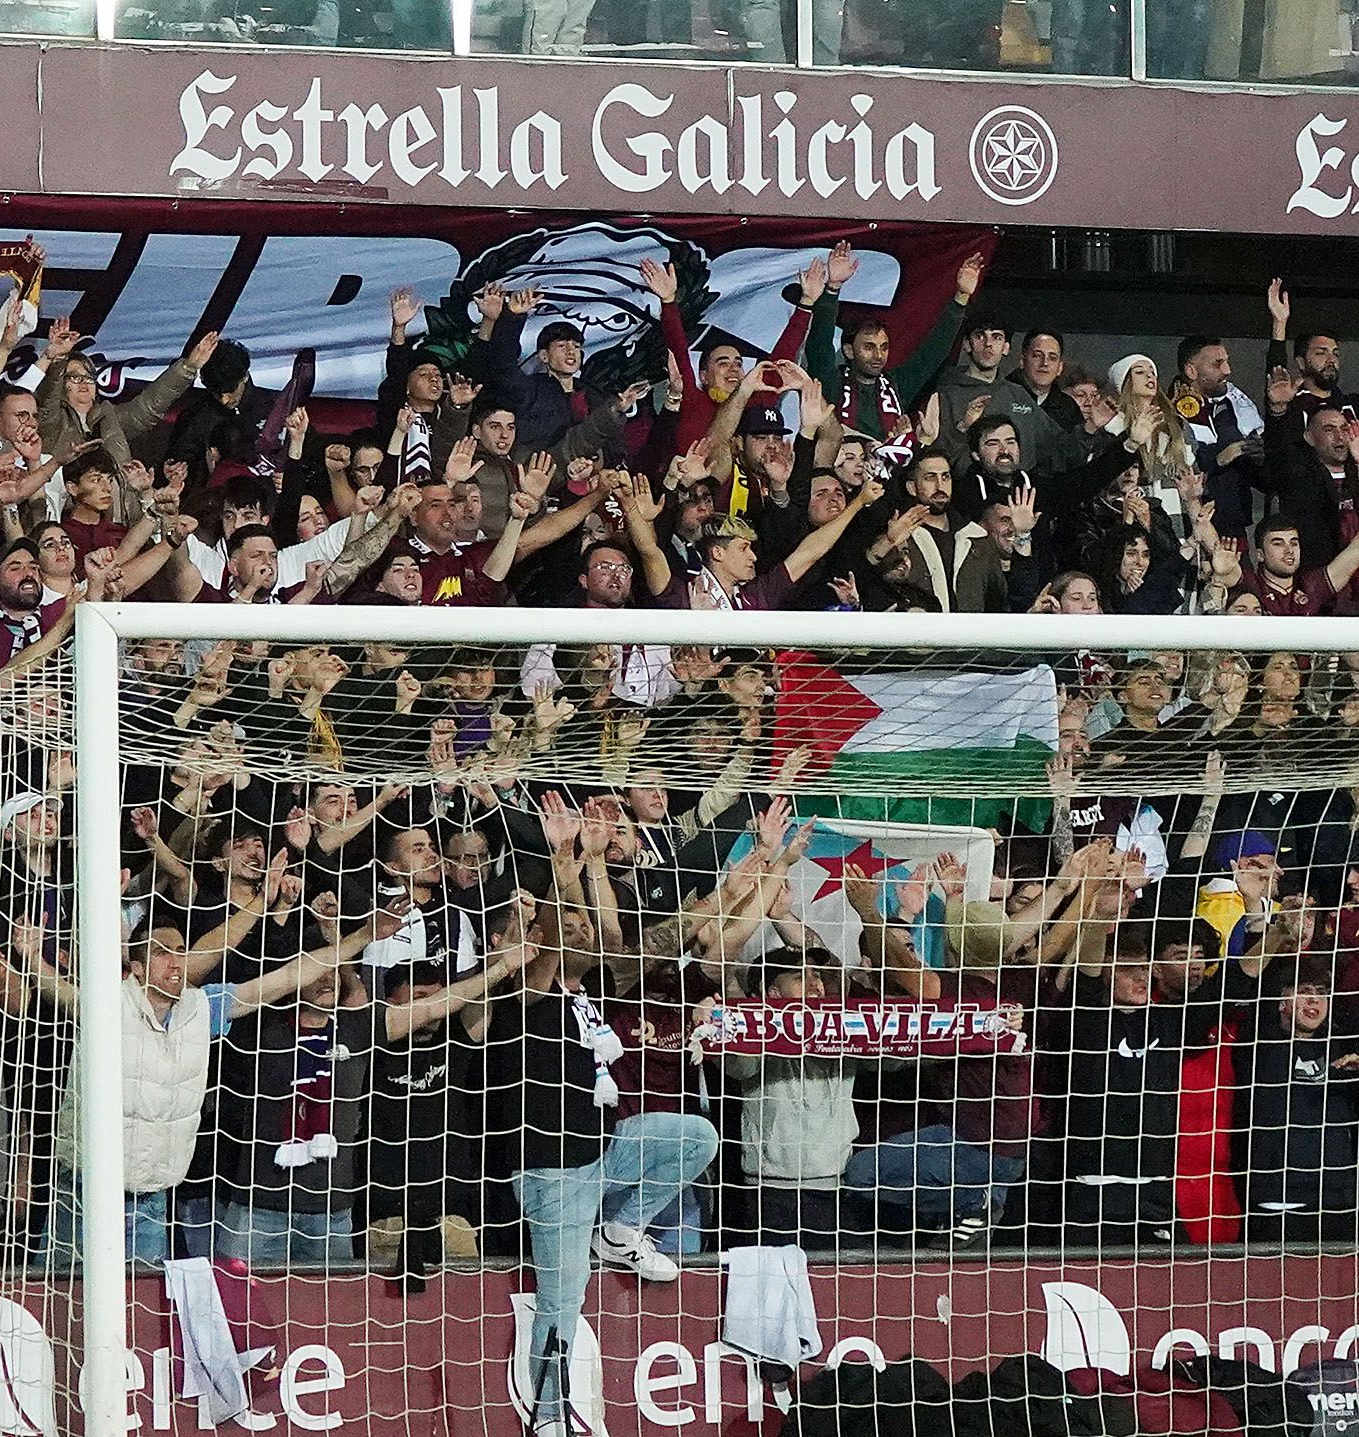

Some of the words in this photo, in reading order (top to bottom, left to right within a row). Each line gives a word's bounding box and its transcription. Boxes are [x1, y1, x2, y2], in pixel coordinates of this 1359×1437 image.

[169, 69, 569, 191] Estrella
[592, 83, 943, 201] Galicia
[1286, 112, 1359, 219] E
[737, 1002, 850, 1044] BOA
[858, 1002, 980, 1044] VILA
